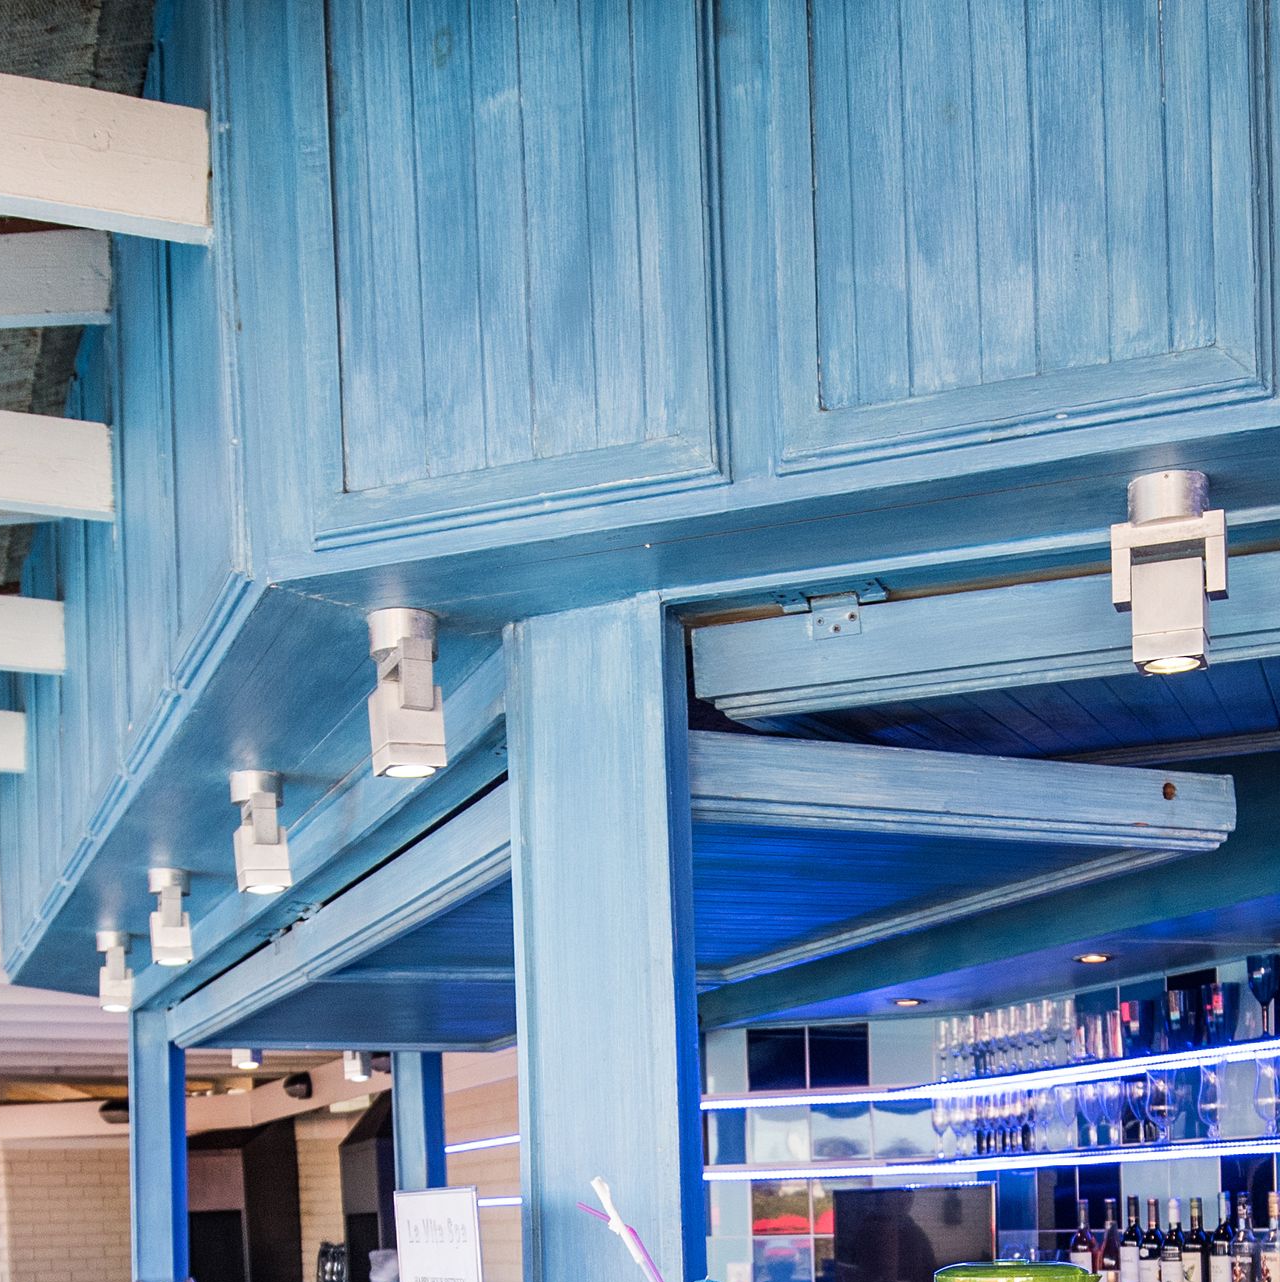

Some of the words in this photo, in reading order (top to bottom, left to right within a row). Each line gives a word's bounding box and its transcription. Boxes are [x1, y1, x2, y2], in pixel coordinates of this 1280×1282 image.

[406, 1218, 420, 1244] La
[422, 1218, 445, 1244] Vita
[447, 1217, 468, 1249] Spa
